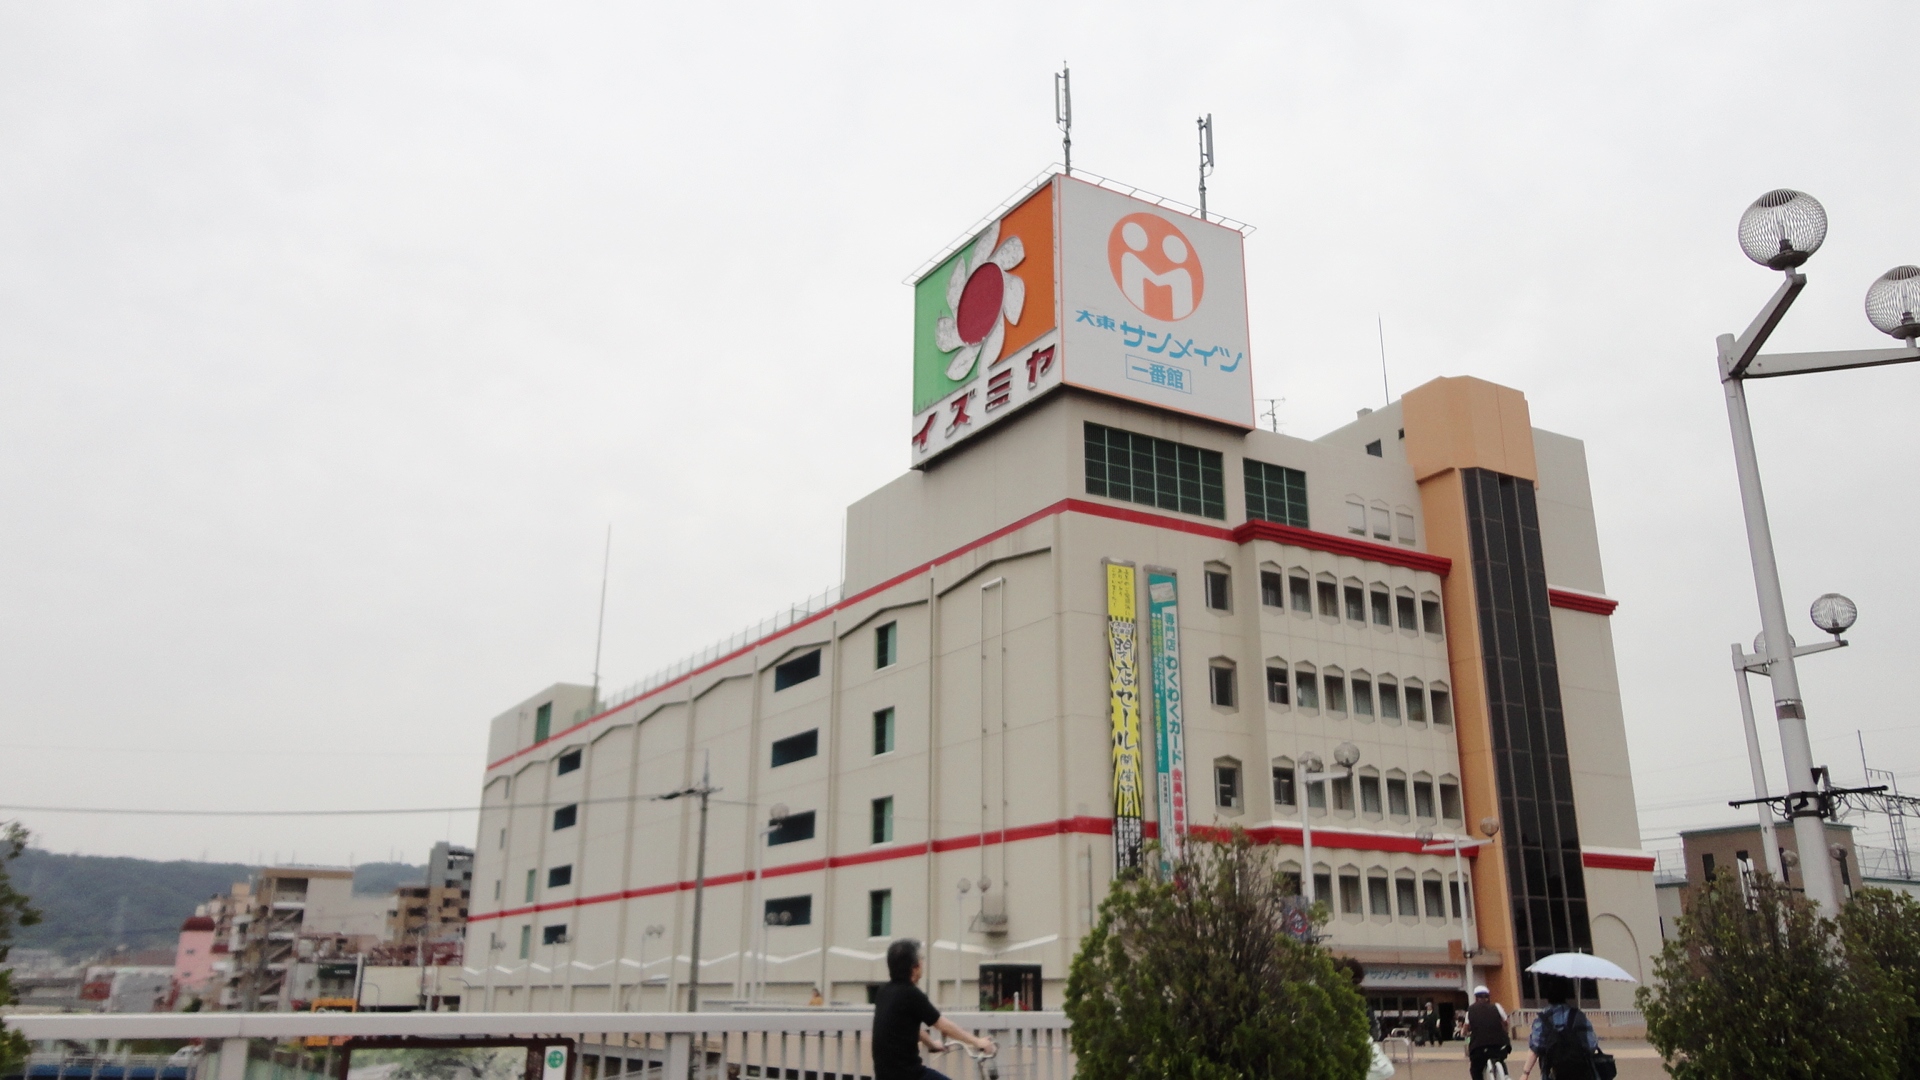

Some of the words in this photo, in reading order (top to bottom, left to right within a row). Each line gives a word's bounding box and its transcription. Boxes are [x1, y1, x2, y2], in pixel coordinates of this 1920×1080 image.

[1075, 310, 1115, 333] 大東
[1120, 321, 1243, 373] サンメイツ
[912, 343, 1057, 453] イズミヤ
[1131, 363, 1184, 391] 一番館
